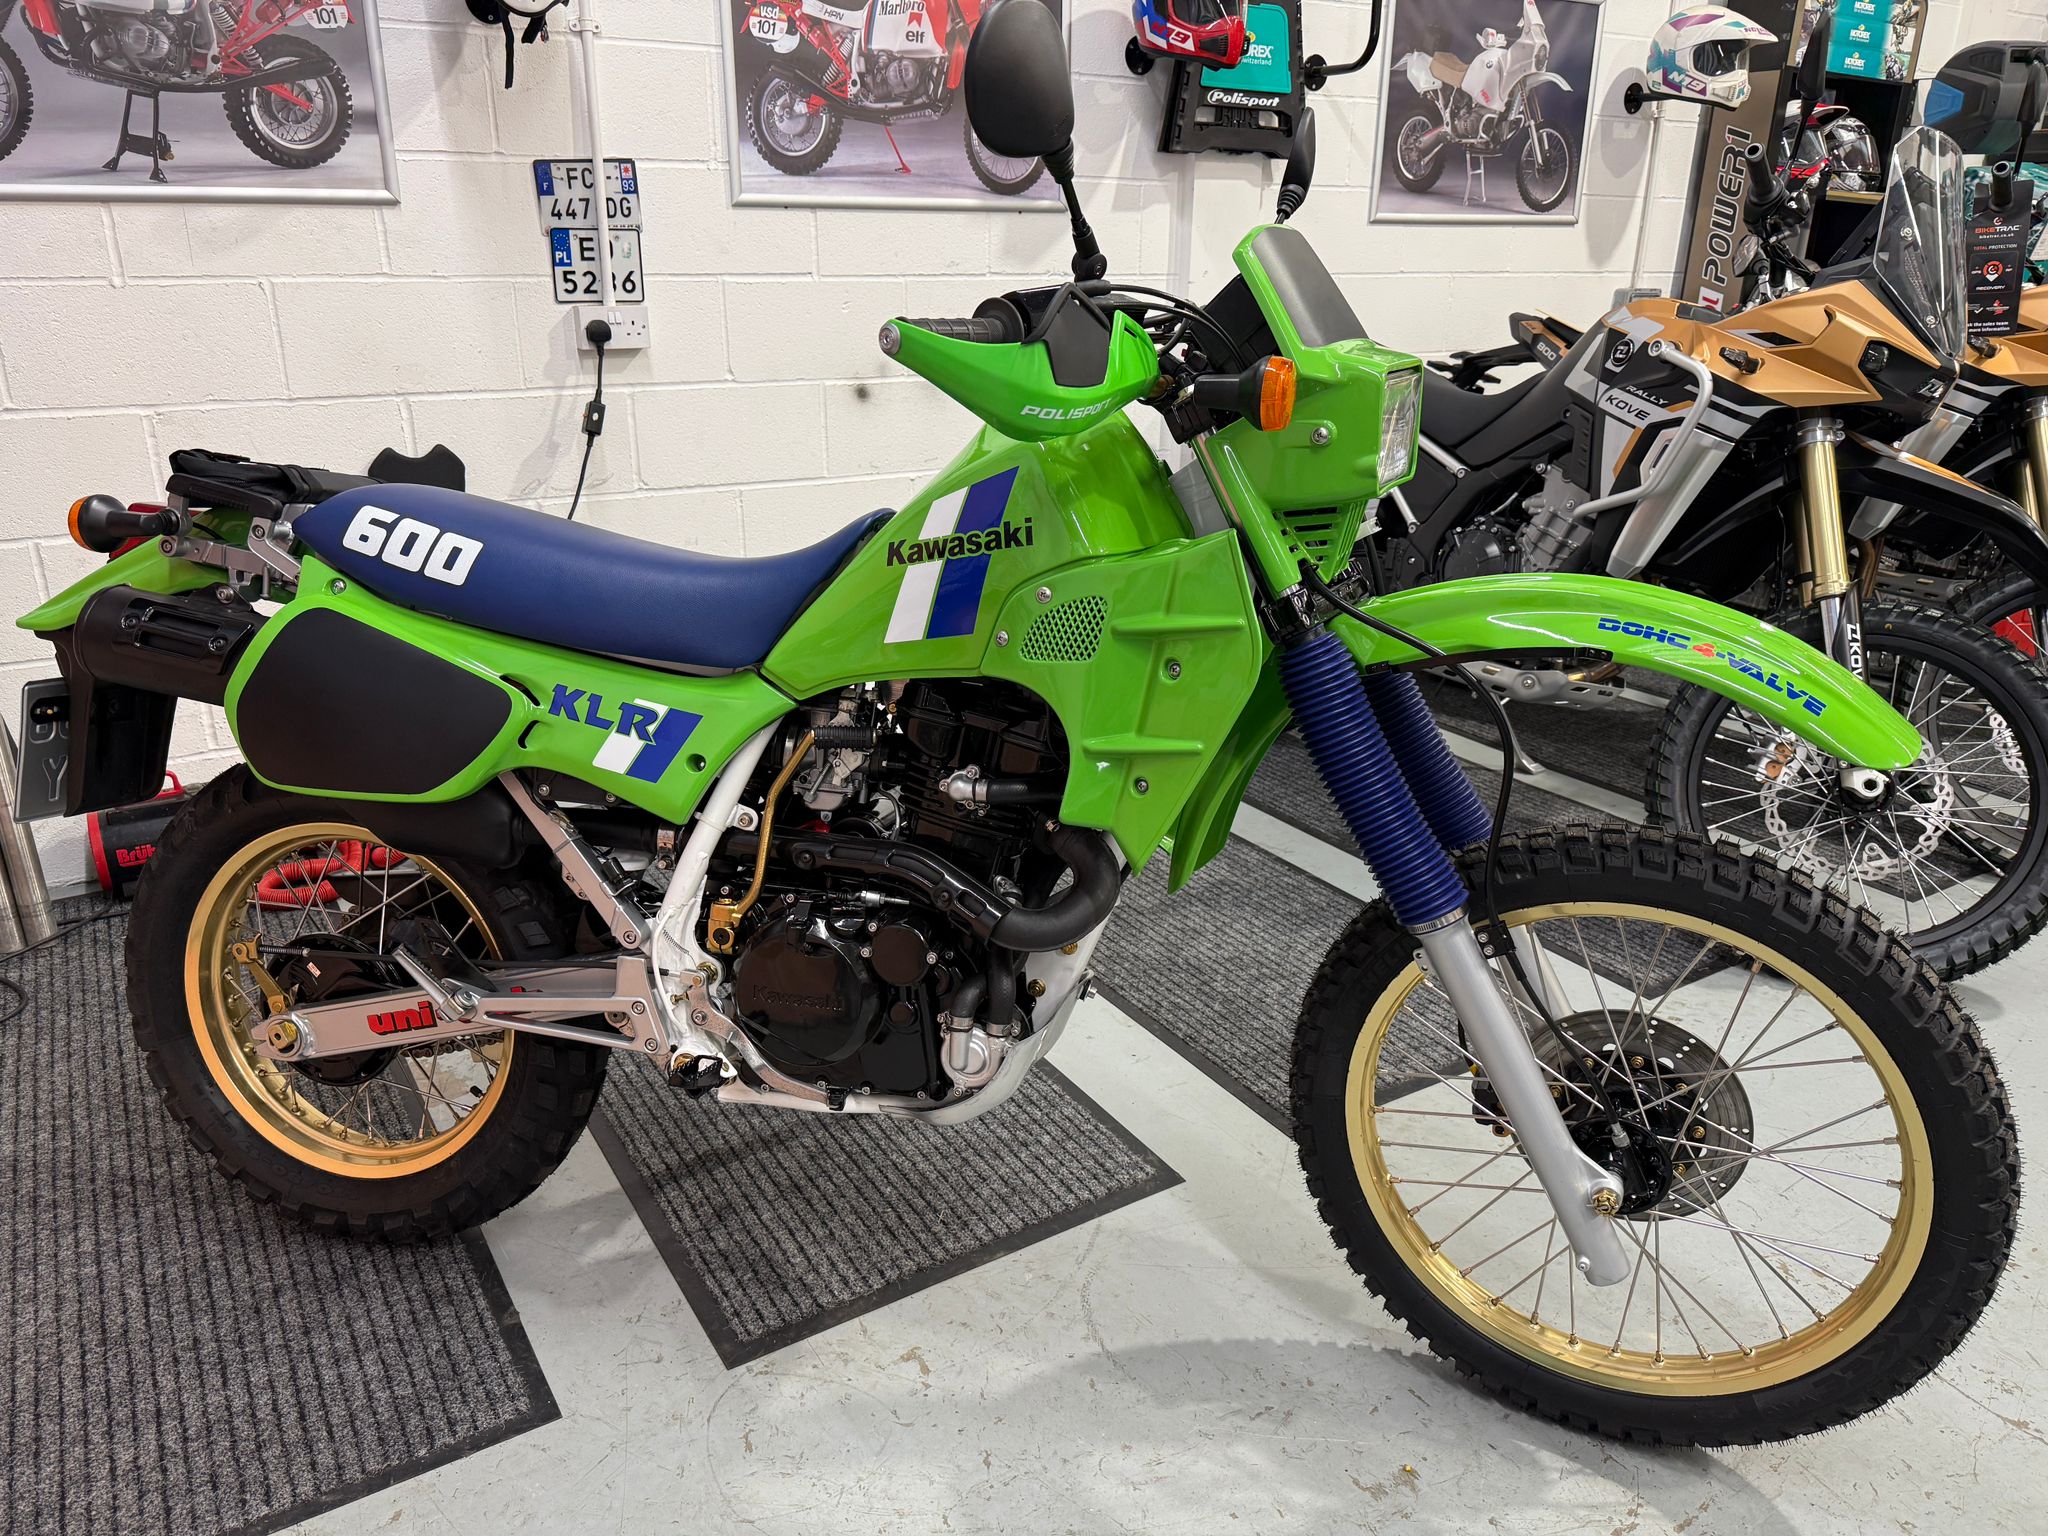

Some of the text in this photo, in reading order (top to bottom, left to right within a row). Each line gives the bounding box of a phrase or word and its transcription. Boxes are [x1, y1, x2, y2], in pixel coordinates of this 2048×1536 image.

[313, 7, 338, 25] 101
[879, 0, 925, 16] Marlboro
[757, 19, 777, 36] 101
[905, 30, 926, 43] elf
[1210, 90, 1280, 107] Polisport
[621, 179, 635, 192] 93
[550, 198, 590, 220] 447
[1702, 125, 1753, 287] POWER1
[1974, 224, 2020, 234] BIKETRAC
[555, 251, 571, 264] PL
[1536, 341, 1558, 361] 800
[1625, 384, 1670, 406] RALLY
[1019, 398, 1112, 421] POLISPORT
[1604, 394, 1651, 421] KOVE
[342, 504, 484, 586] 600
[886, 516, 1034, 567] Kawasaki
[1597, 616, 1692, 650] DOHC
[547, 682, 657, 745] KLR
